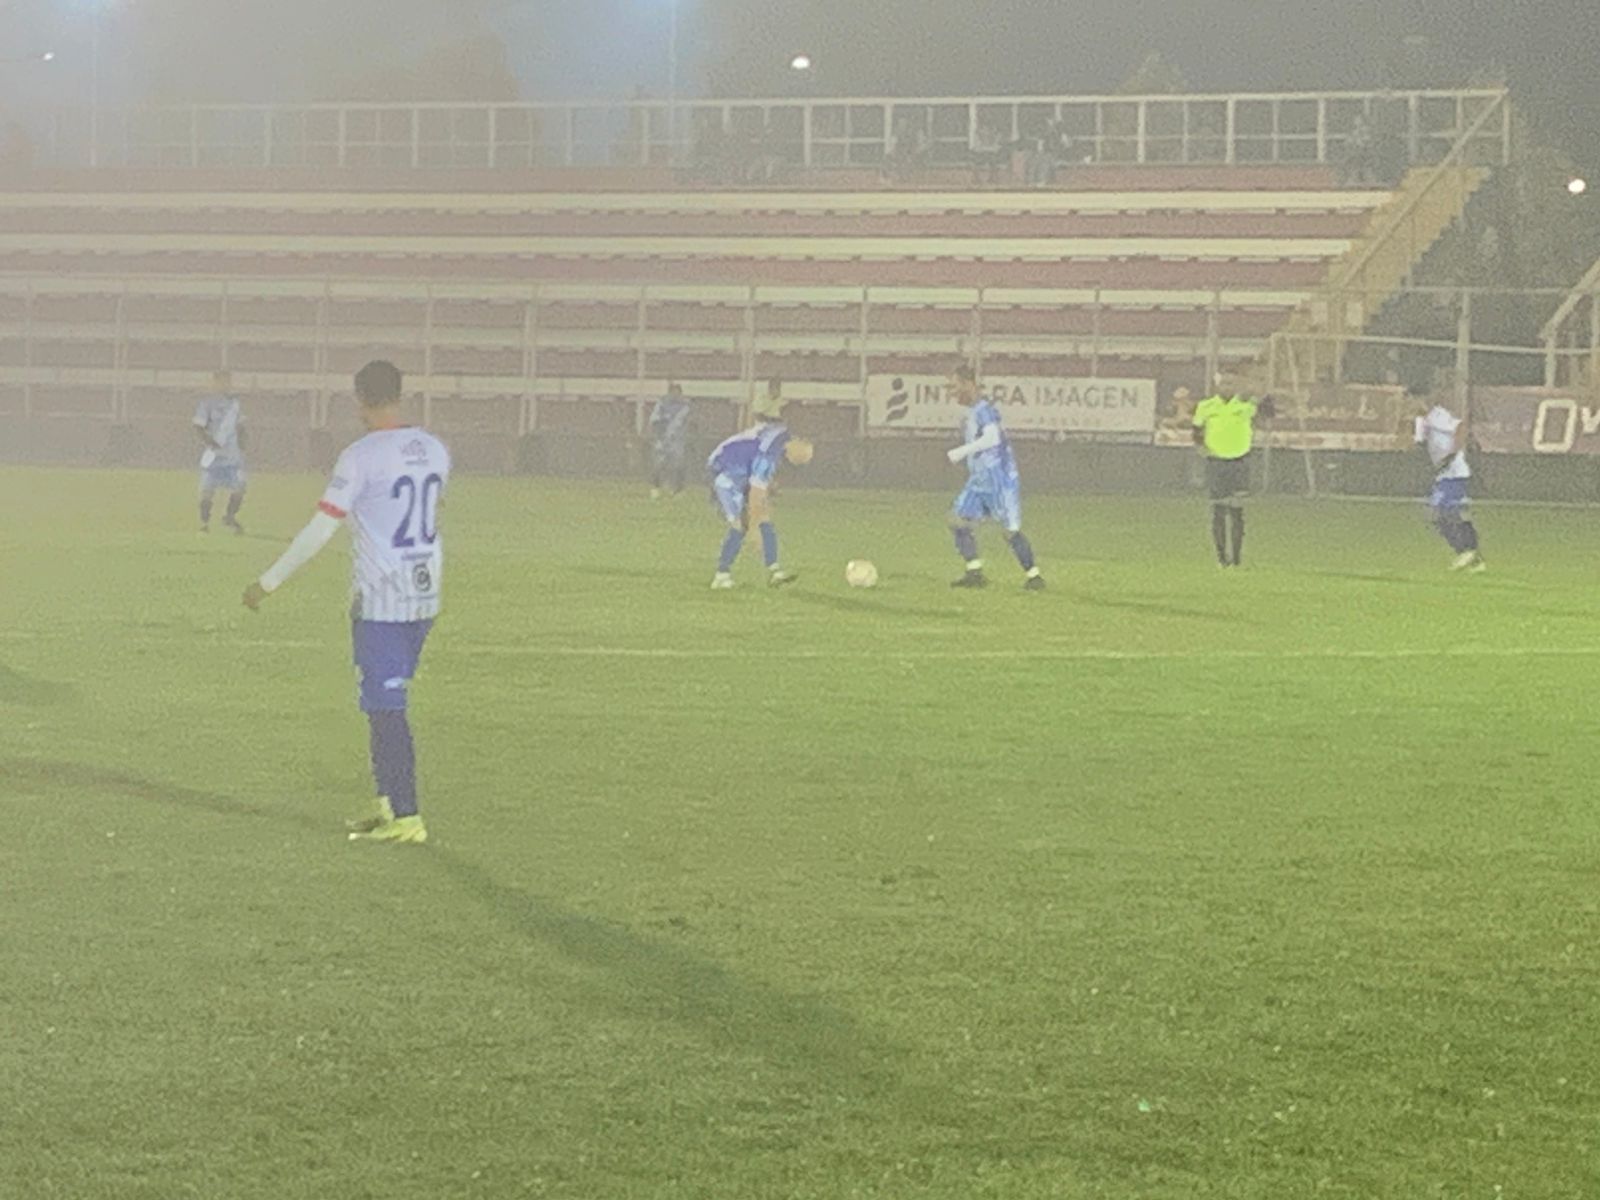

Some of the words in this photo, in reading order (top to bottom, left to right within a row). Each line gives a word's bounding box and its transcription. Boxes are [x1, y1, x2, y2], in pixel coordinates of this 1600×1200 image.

[915, 384, 1027, 406] INTRA
[1035, 386, 1138, 408] IMAGEN
[391, 473, 441, 547] 20
